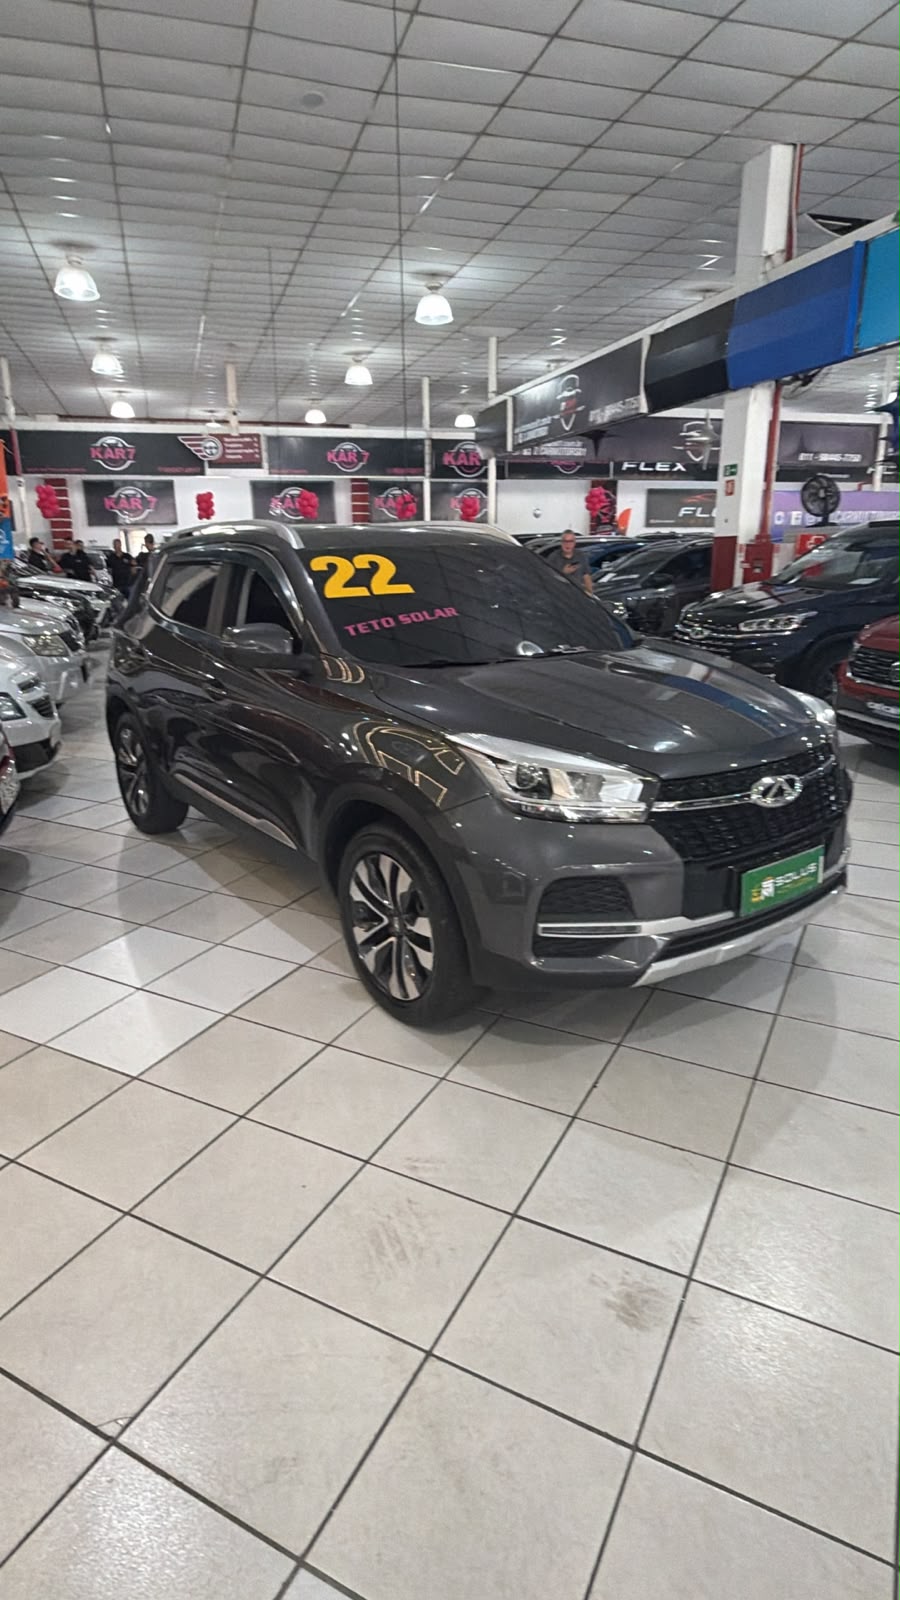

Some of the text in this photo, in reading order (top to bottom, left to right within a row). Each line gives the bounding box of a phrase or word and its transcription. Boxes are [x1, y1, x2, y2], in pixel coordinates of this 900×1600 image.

[327, 451, 358, 463] KAR
[443, 452, 480, 466] KAR
[621, 461, 687, 472] FLEX
[104, 497, 143, 510] KAR
[309, 553, 416, 599] 22
[344, 606, 460, 637] TETO SOLAR
